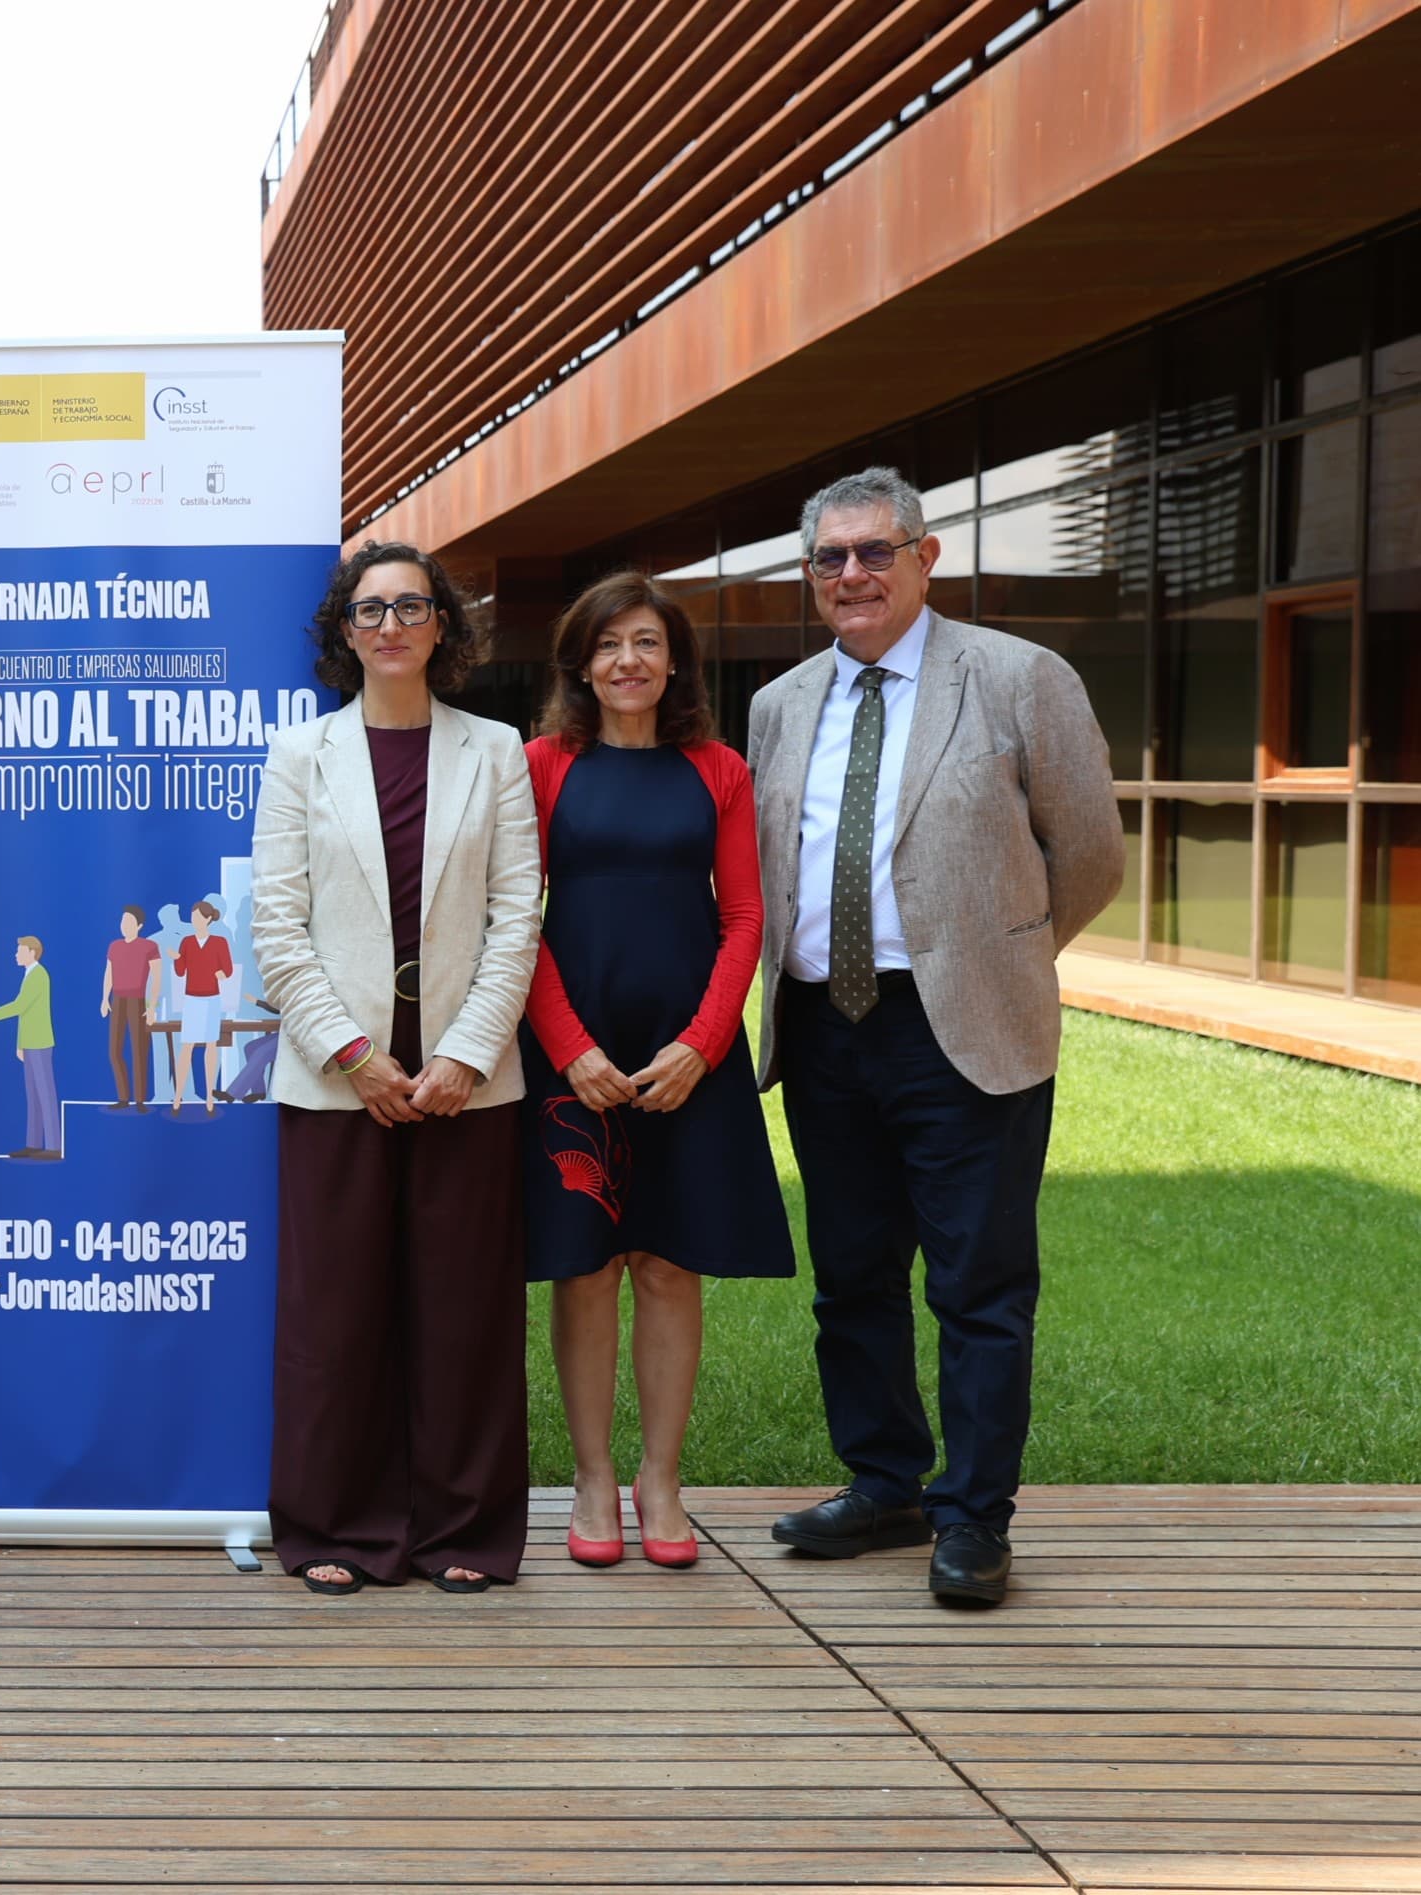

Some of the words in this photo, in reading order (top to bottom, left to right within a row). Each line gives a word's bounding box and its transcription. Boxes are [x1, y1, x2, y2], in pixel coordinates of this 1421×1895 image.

[0, 406, 30, 416] ESPAÑA
[52, 397, 96, 405] MINISTERIO
[64, 406, 98, 414] TRABAJO
[168, 399, 208, 414] insst
[60, 414, 103, 423] ECONOMÍA
[105, 414, 133, 422] SOCIAL
[94, 572, 211, 620] TÉCNICA
[57, 655, 72, 679] DE
[76, 654, 141, 679] EMPRESAS
[144, 654, 221, 678] SALUDABLES
[68, 689, 119, 748] AL
[127, 688, 317, 747] TRABAJO
[164, 752, 264, 820] integr
[75, 1220, 247, 1262] 04-06-2025
